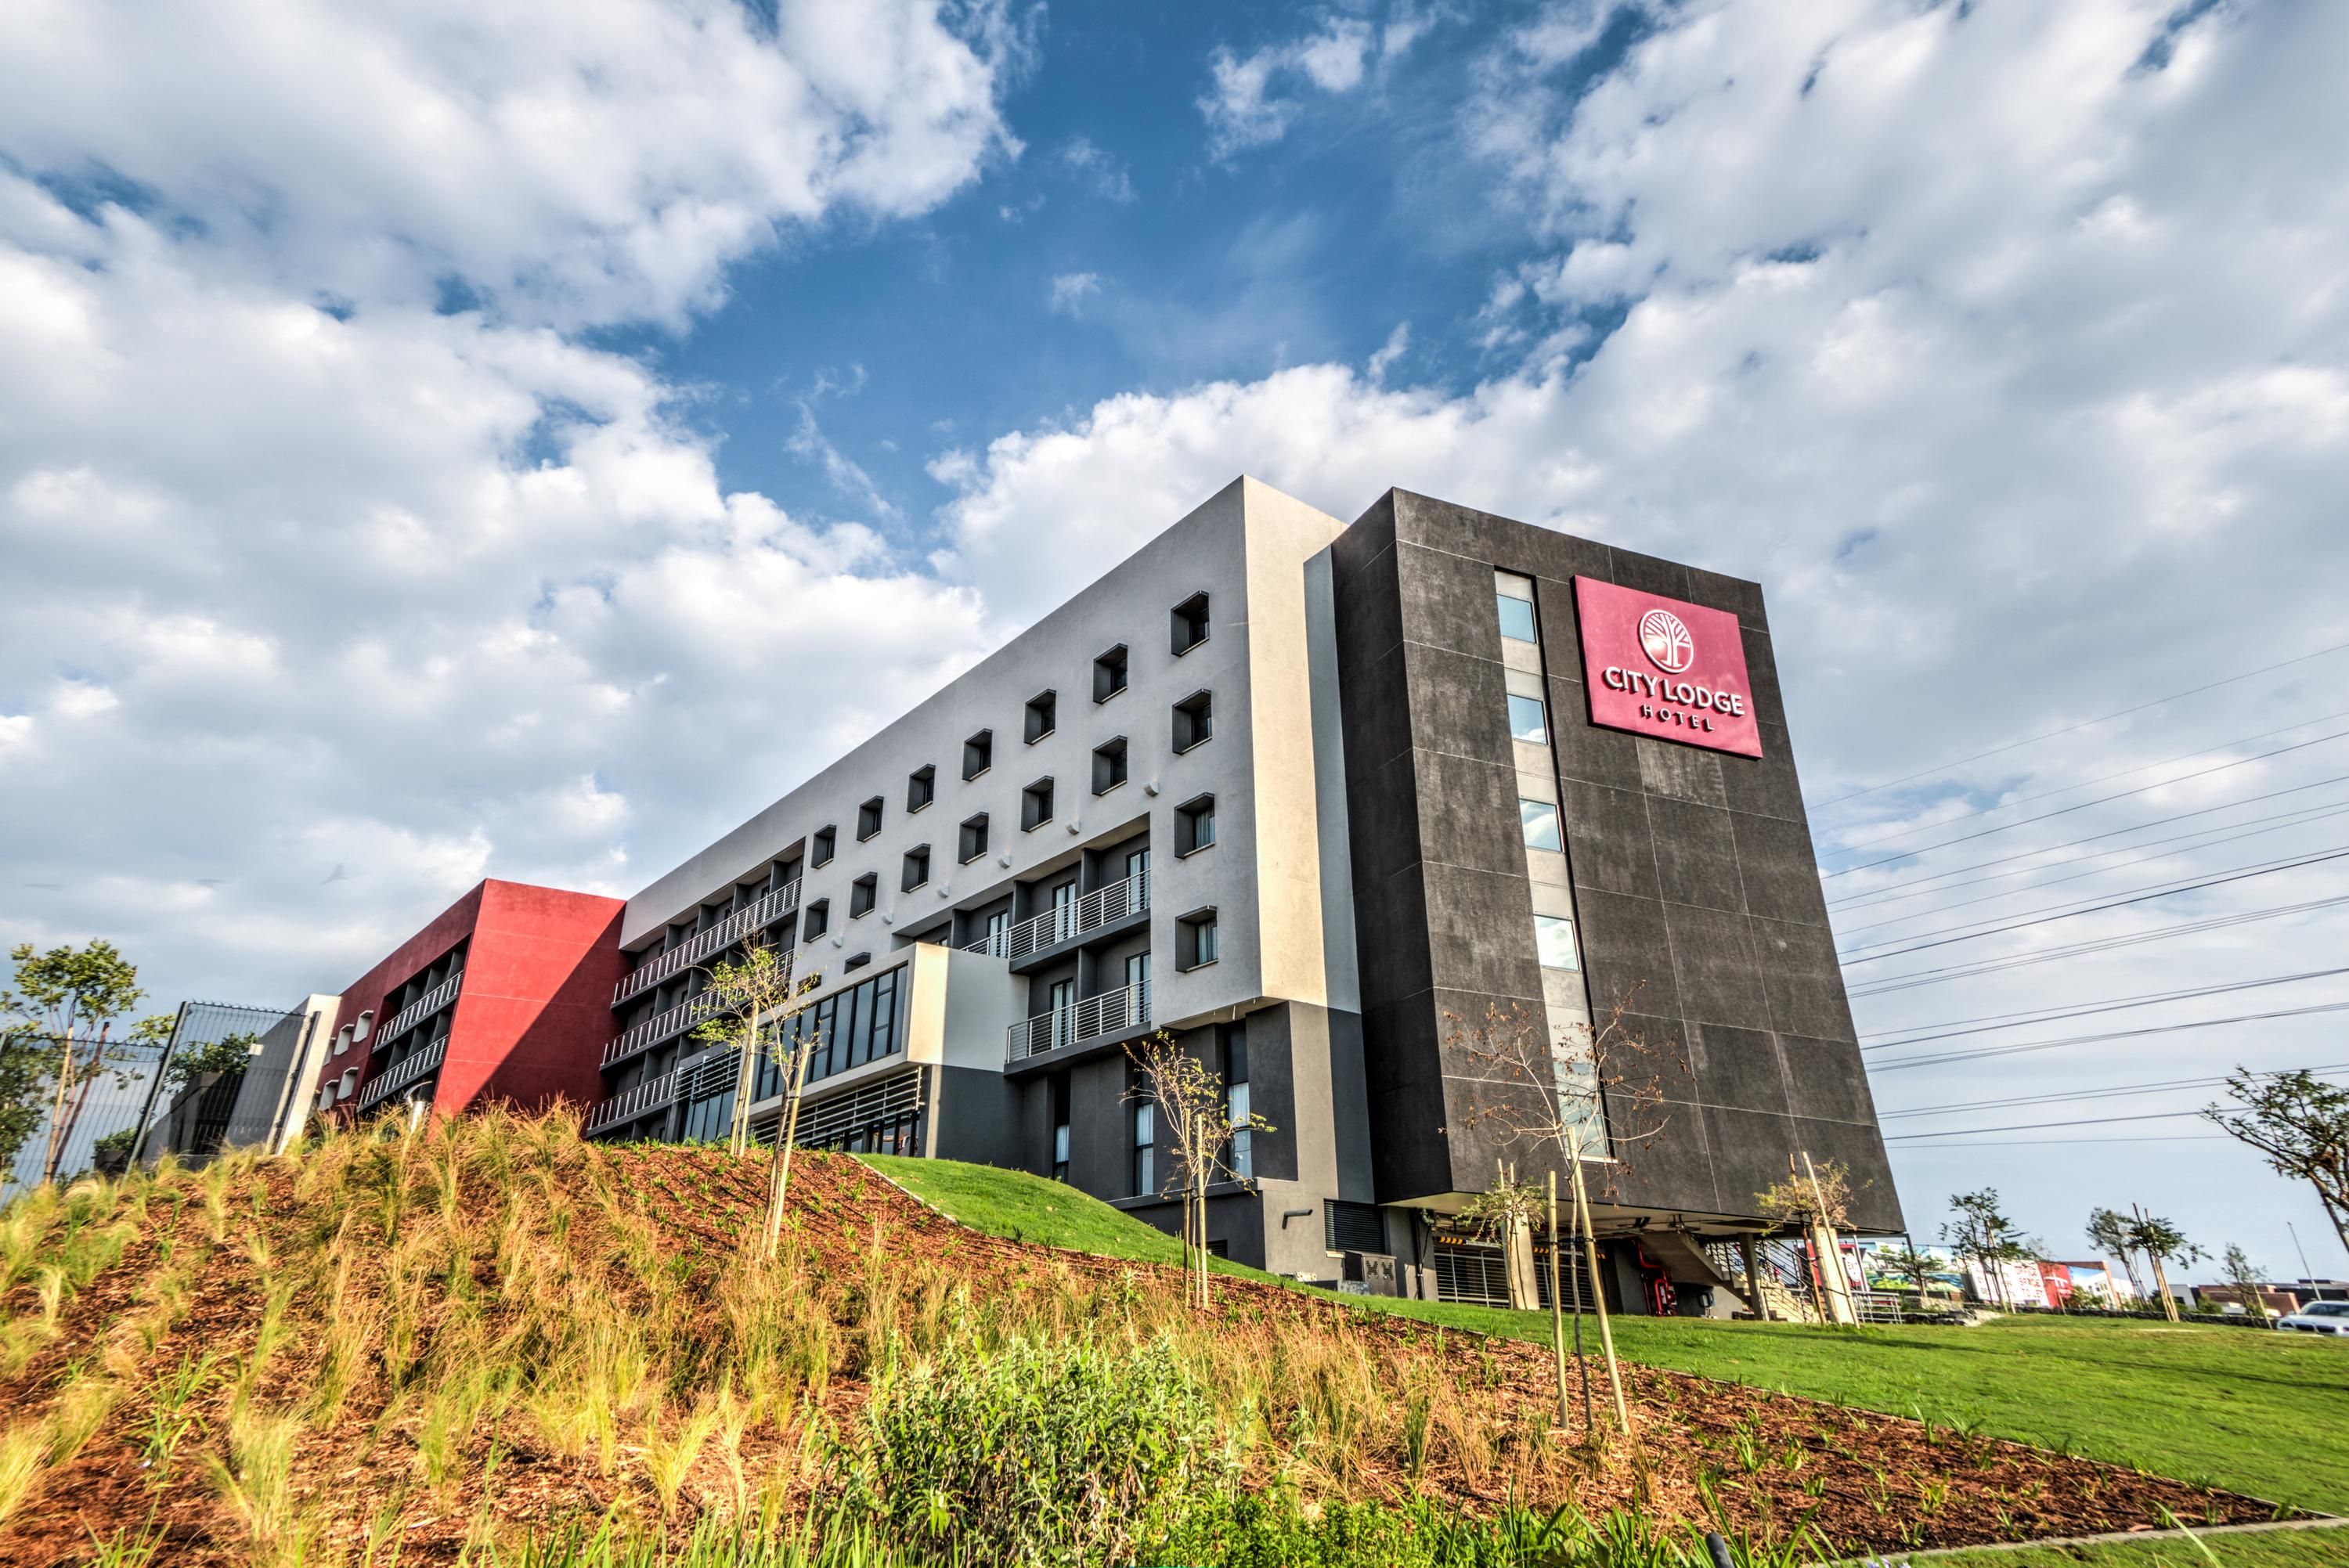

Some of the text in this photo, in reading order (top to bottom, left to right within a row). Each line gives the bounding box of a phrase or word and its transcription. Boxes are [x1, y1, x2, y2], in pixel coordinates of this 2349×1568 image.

[1604, 666, 1745, 716] CITY LODGE
[1643, 703, 1715, 730] HOTEL
